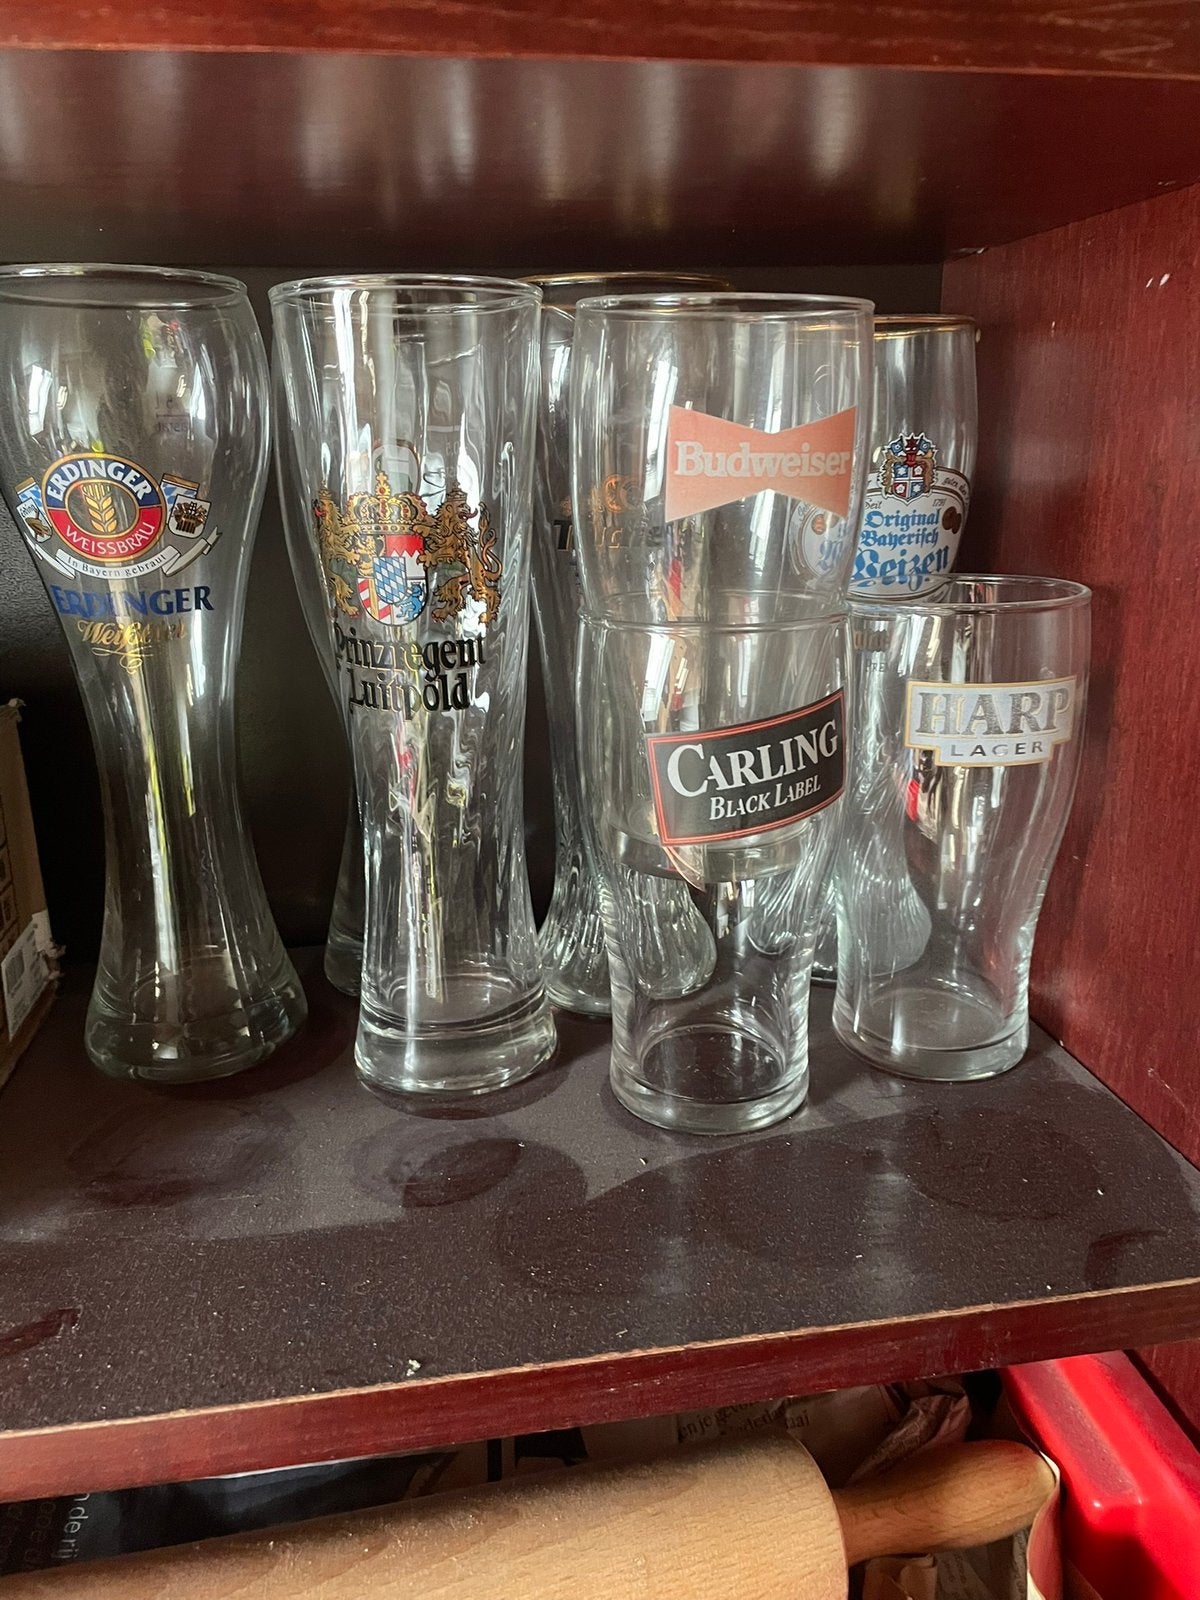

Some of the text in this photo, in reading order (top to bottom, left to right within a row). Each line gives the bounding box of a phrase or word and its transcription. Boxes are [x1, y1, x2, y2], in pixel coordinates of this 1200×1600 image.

[674, 439, 851, 479] Budweiser
[46, 459, 152, 501] ERDINGER
[65, 521, 156, 555] WEISSBRÄU
[865, 508, 941, 531] Original
[82, 564, 120, 577] Bayern
[124, 554, 167, 577] gebraut
[50, 585, 214, 618] ERDINGER
[347, 668, 473, 721] Luitpold
[915, 686, 1073, 738] HARP
[667, 717, 838, 797] CARLING
[949, 740, 1044, 759] LAGER
[709, 773, 821, 821] BLACK LABEL
